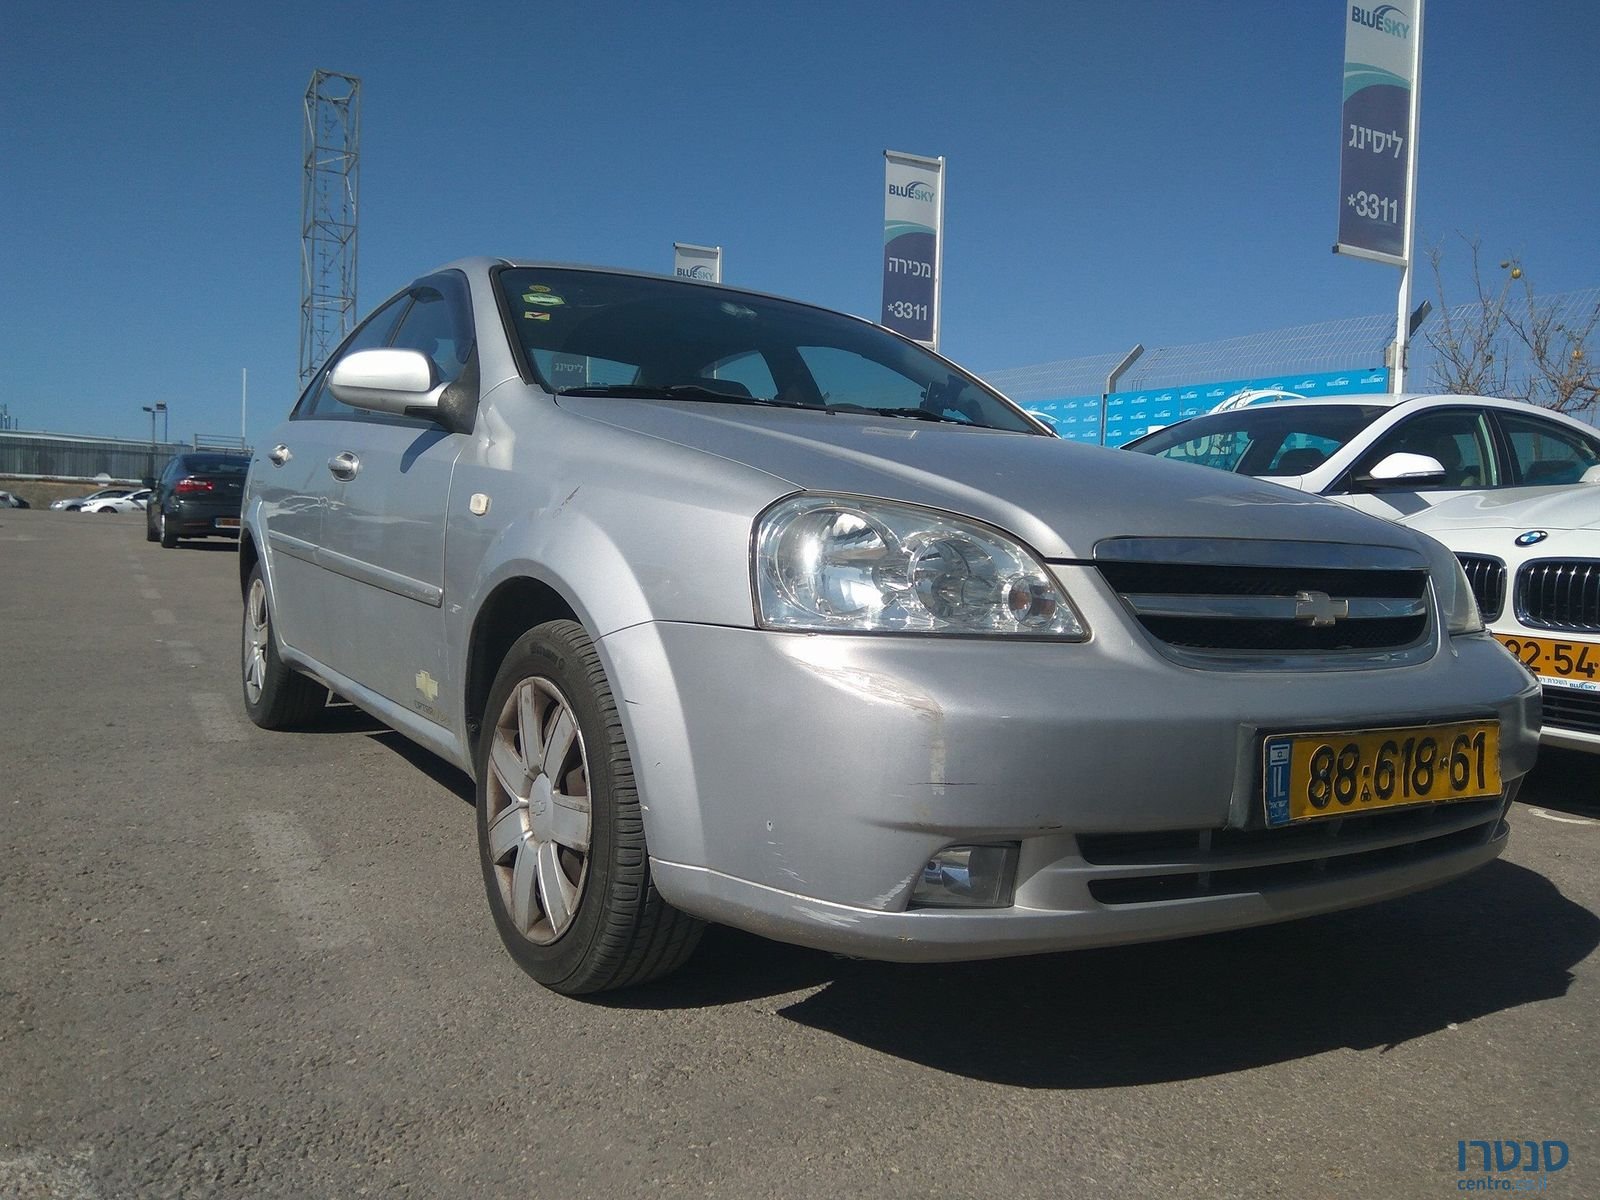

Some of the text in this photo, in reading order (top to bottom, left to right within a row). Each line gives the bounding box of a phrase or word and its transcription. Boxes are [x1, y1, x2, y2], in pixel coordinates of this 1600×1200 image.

[1352, 5, 1410, 39] BLUESKY
[1349, 124, 1404, 158] ליסינג
[889, 182, 935, 203] BLUESKY
[677, 266, 714, 280] BLUESKY
[889, 256, 931, 278] מכירה
[1273, 766, 1286, 798] IL
